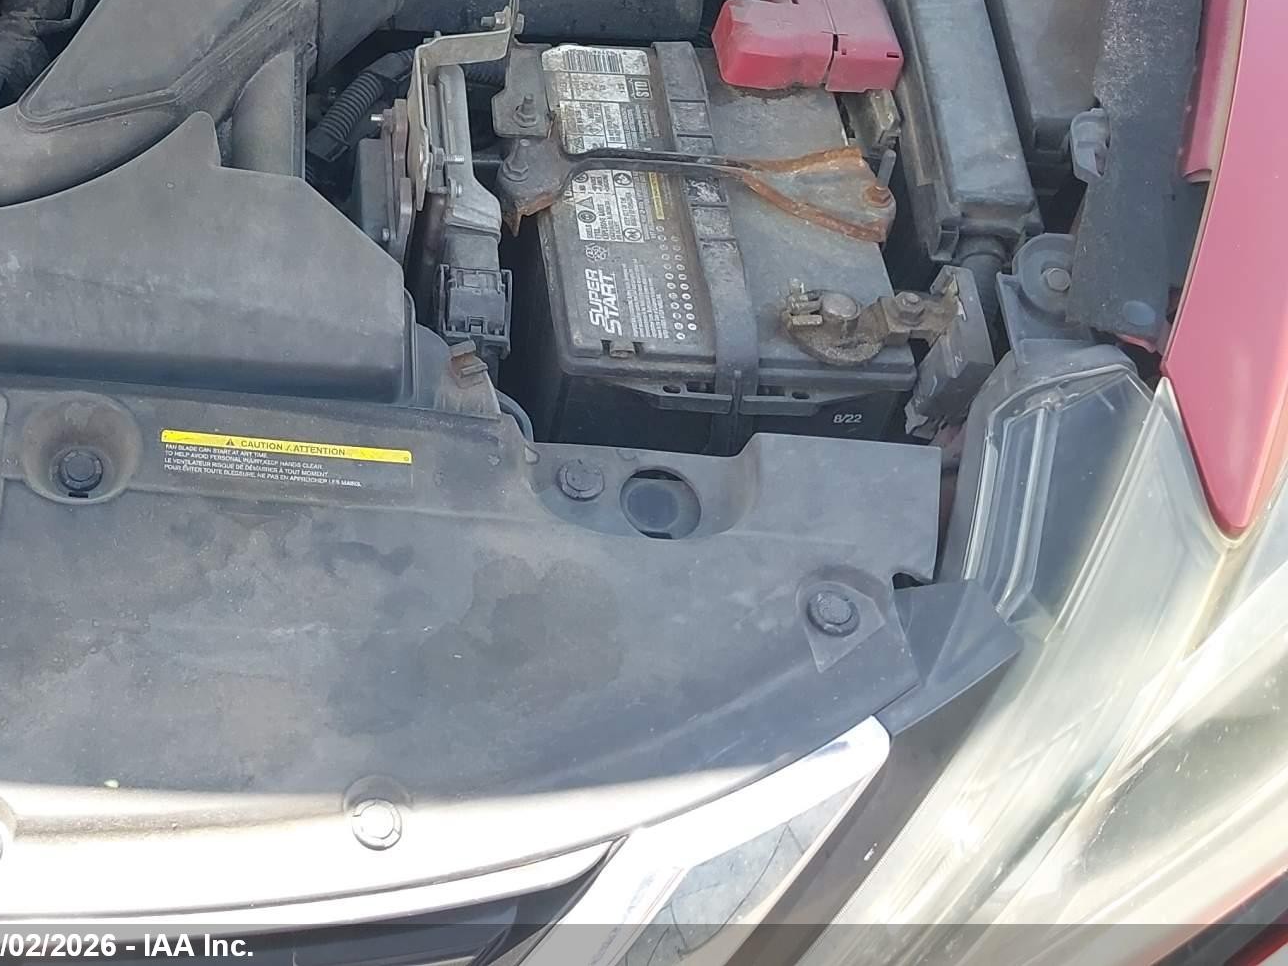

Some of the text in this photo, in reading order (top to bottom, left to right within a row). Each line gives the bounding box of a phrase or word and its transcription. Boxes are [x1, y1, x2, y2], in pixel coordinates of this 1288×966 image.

[585, 268, 606, 328] SUPER
[598, 269, 623, 337] START
[833, 414, 862, 423] 8/22
[241, 440, 283, 450] CAUTION
[293, 445, 345, 455] ATTENTION
